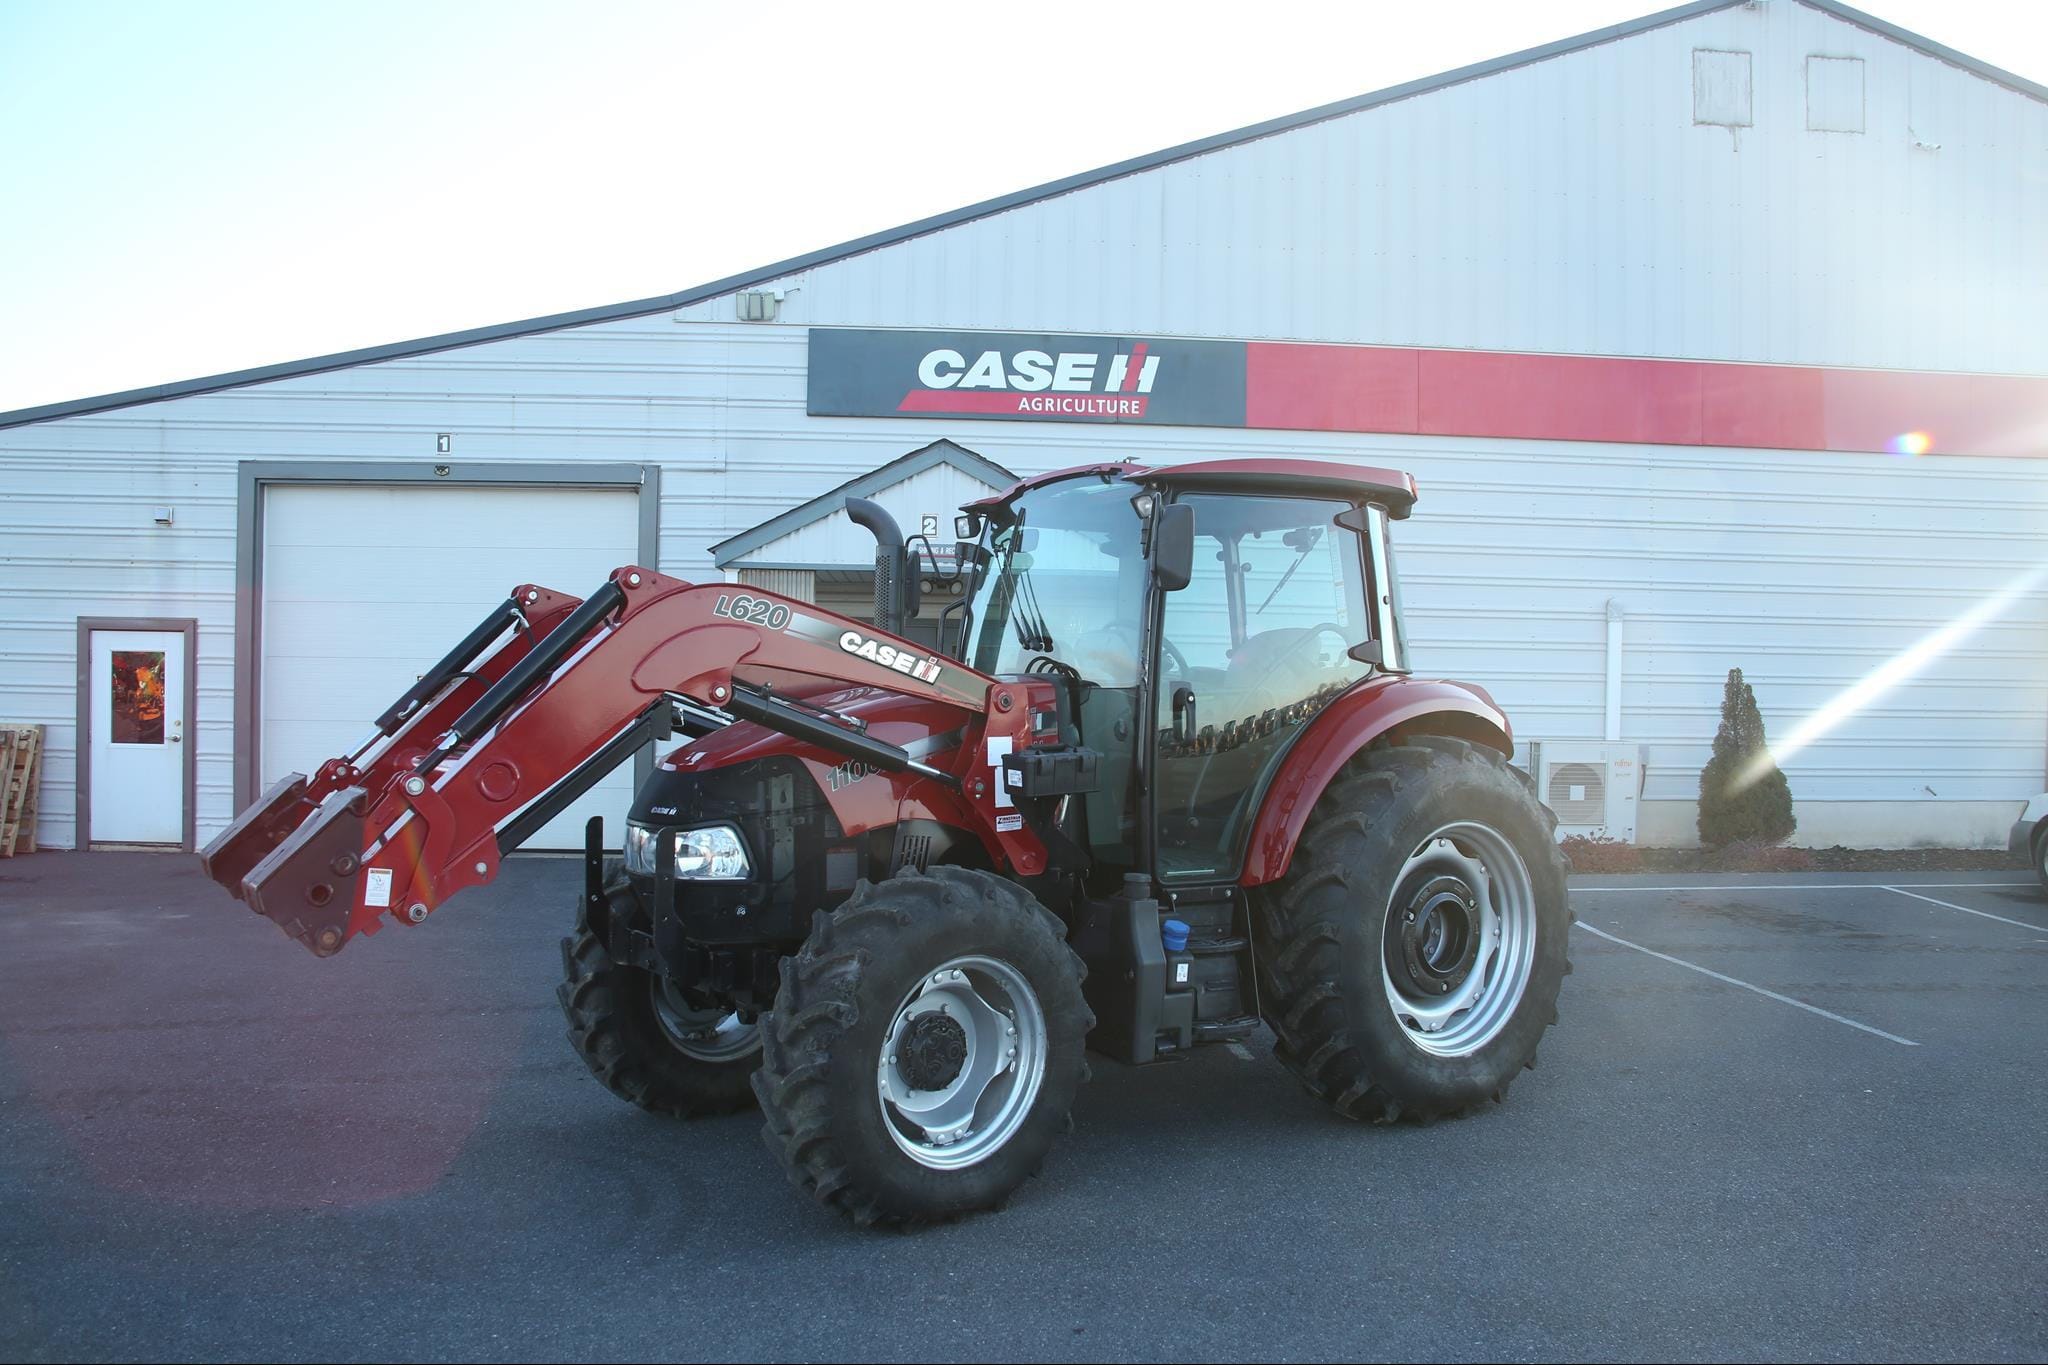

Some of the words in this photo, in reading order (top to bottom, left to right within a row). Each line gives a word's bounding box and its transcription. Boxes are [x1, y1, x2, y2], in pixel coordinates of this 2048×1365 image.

[918, 349, 1097, 392] CASE
[1018, 396, 1140, 415] AGRICULTURE
[439, 435, 449, 452] 1
[923, 517, 936, 535] 2
[713, 595, 790, 630] L620
[839, 631, 915, 675] CASE
